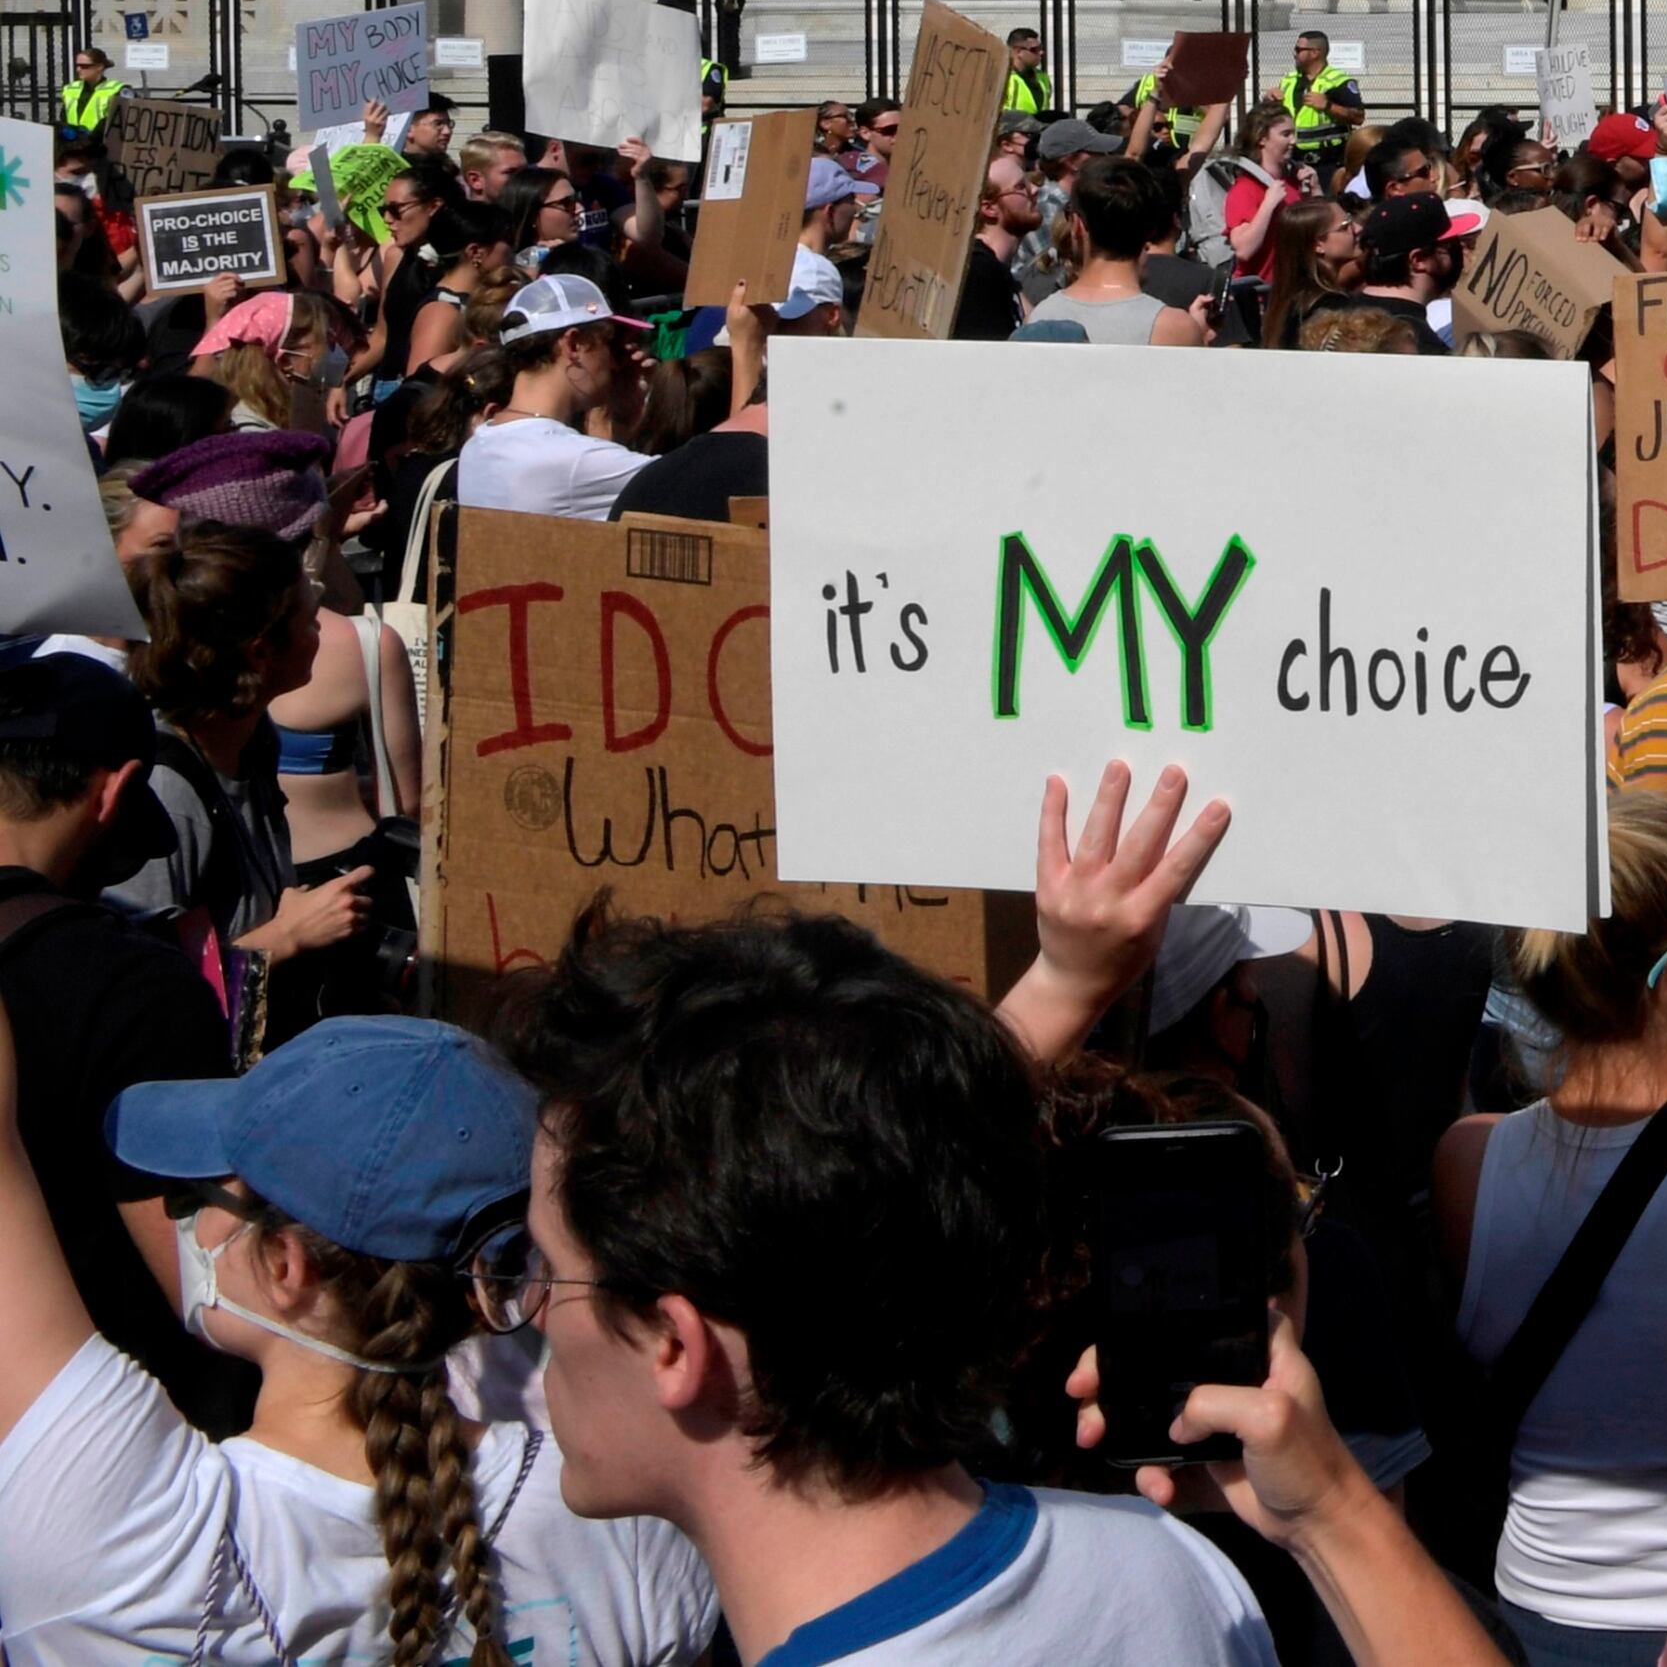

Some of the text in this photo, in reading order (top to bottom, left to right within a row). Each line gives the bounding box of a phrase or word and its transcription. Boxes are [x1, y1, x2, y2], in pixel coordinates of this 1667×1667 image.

[307, 11, 420, 59] MY BODY
[310, 52, 427, 113] MY CHOICE
[105, 105, 220, 153] ABORTION
[133, 147, 178, 167] IS A
[152, 209, 262, 232] PRO-CHOICE
[182, 231, 238, 253] IS THE
[162, 251, 263, 276] MAJORITY
[1467, 232, 1529, 319] NO
[1525, 271, 1576, 328] FORCED
[822, 530, 1532, 733] it's MY choice
